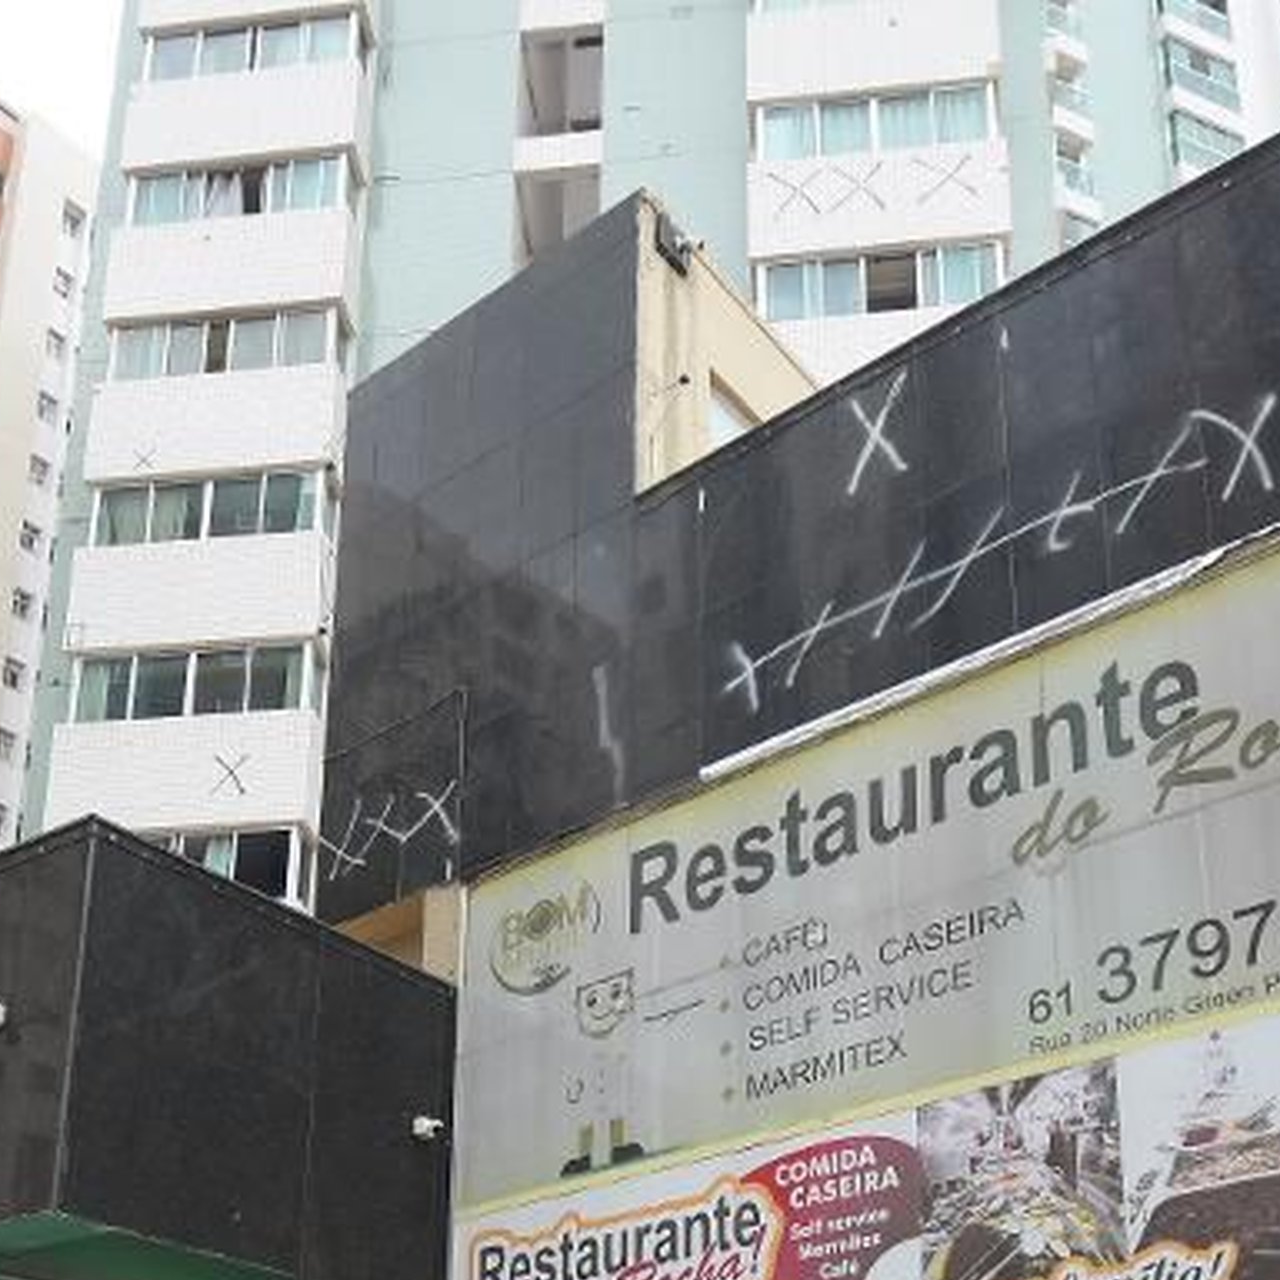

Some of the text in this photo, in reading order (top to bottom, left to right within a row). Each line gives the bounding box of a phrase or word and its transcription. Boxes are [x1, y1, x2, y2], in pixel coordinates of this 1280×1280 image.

[628, 658, 1202, 934] Restaurante
[1012, 789, 1111, 867] do
[741, 898, 1026, 1012] COMIDA CASEIRA
[748, 960, 975, 1052] SELF SERVICE
[1028, 981, 1071, 1025] 61
[744, 1029, 908, 1101] MARMITEX
[1028, 1032, 1071, 1056] Rua
[775, 1144, 877, 1187] COMIDA
[789, 1165, 901, 1209] CASEIRA
